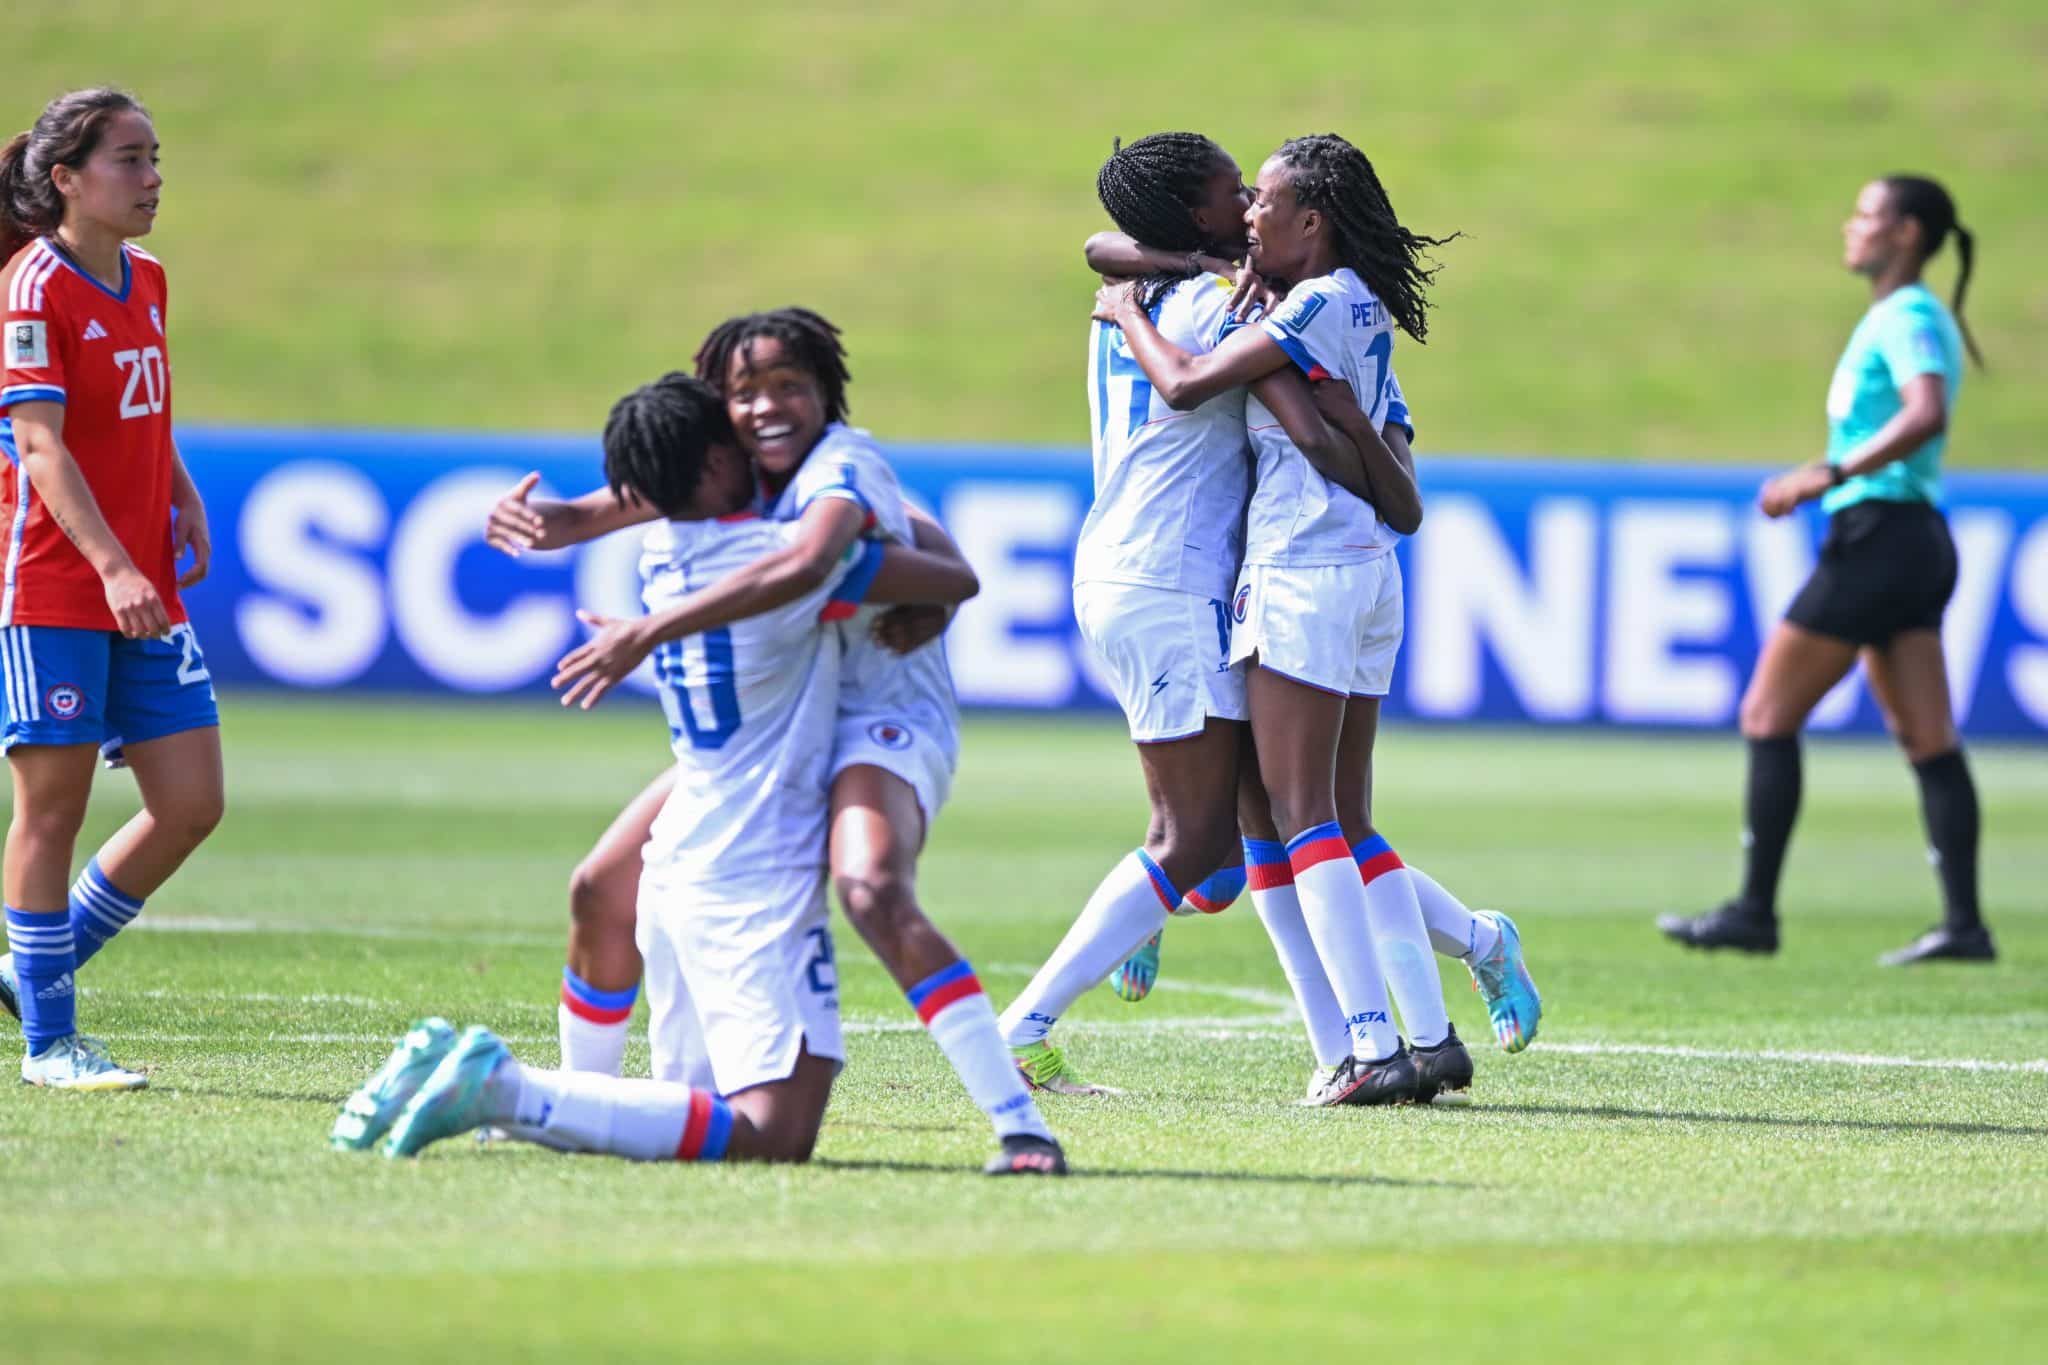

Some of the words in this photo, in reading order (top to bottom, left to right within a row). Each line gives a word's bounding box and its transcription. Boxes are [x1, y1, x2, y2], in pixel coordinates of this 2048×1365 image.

[1349, 300, 1386, 328] PET
[113, 345, 165, 419] 20
[1346, 1011, 1387, 1030] AETA
